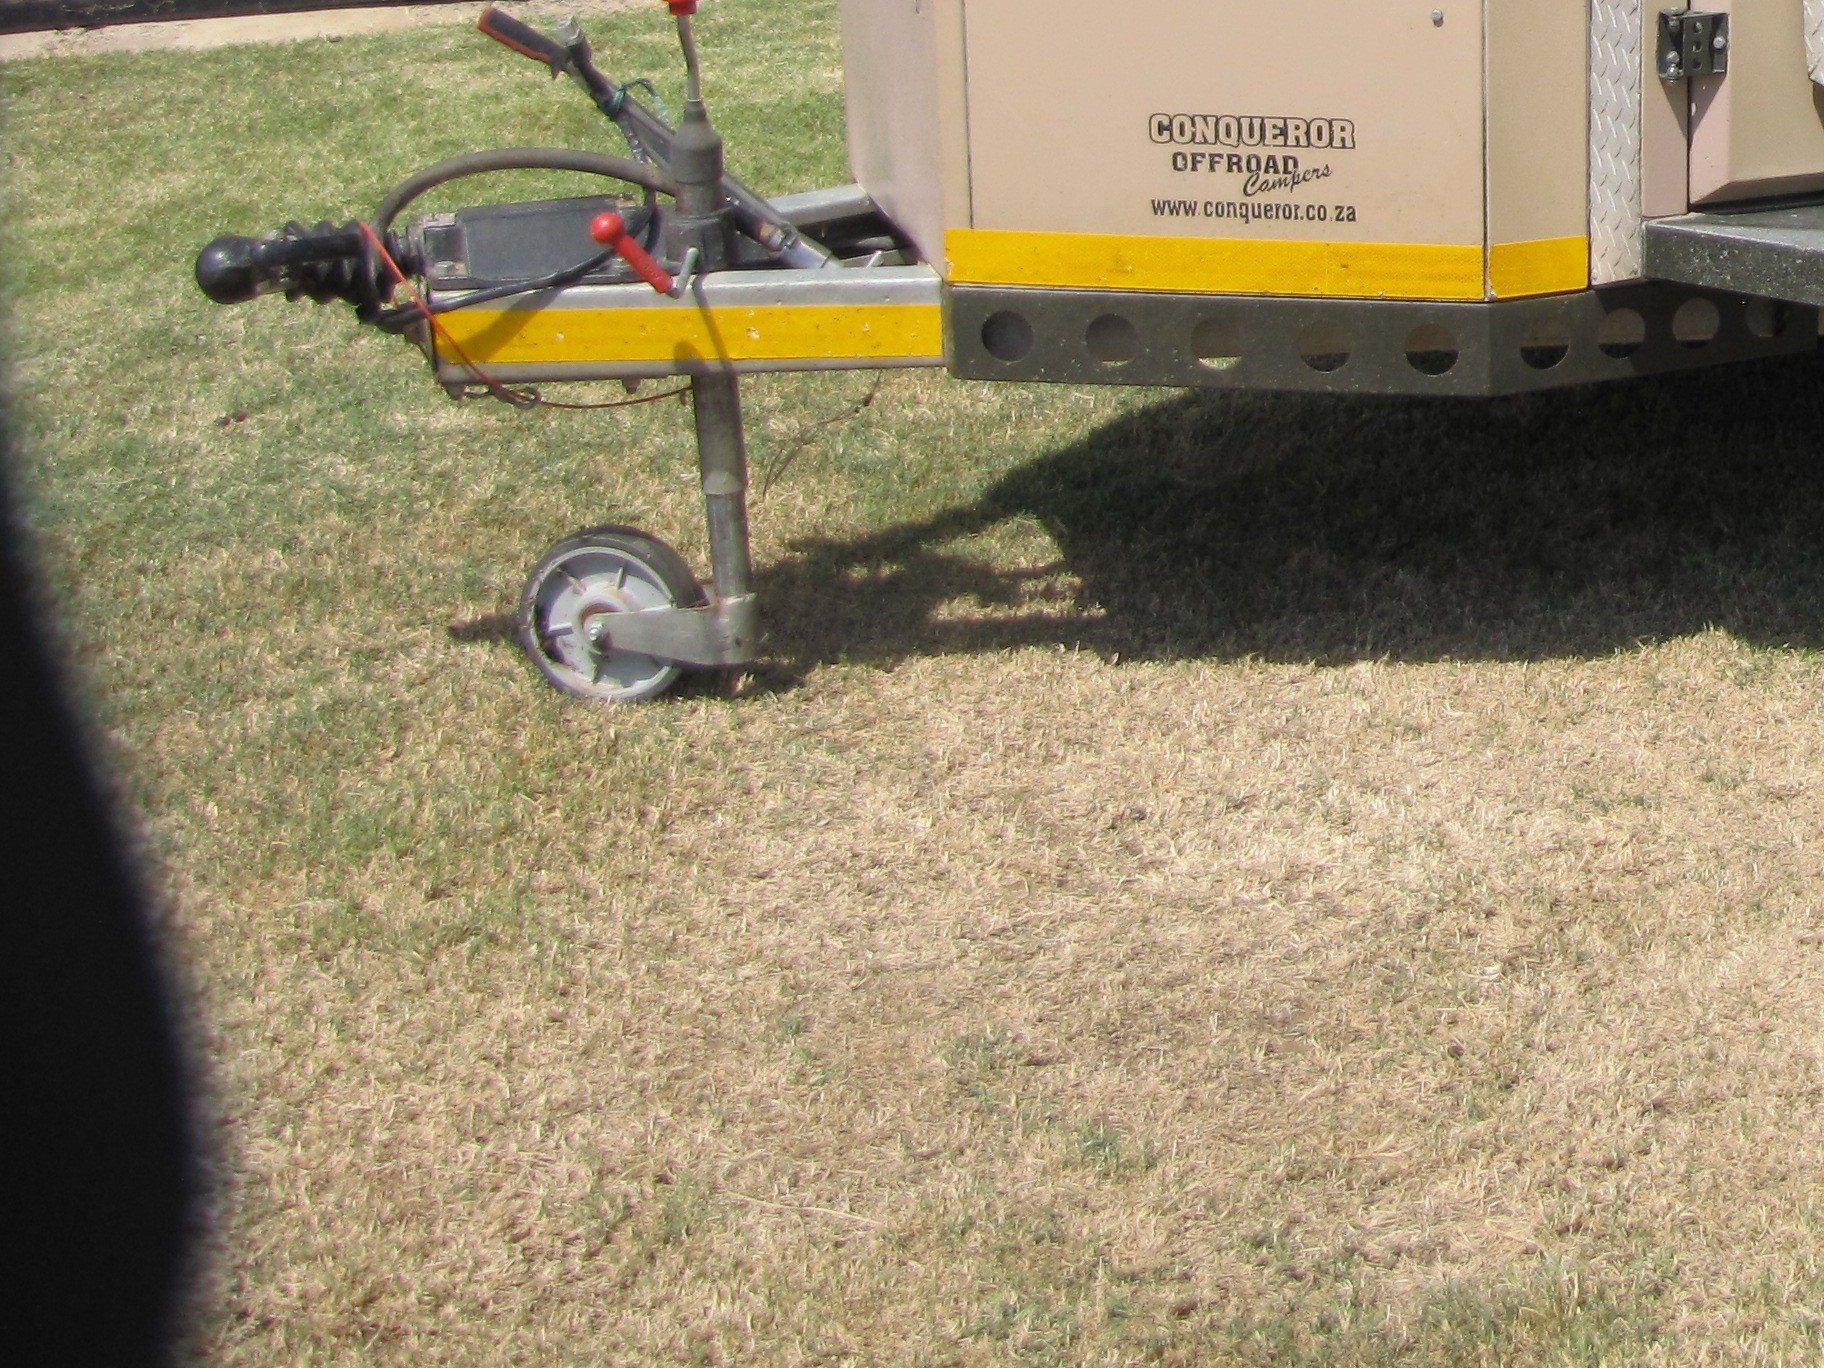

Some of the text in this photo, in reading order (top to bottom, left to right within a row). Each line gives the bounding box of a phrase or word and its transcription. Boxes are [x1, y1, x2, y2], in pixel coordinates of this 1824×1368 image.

[1149, 113, 1356, 150] CONQUEROR
[1171, 151, 1299, 175] OFFROAD
[1242, 163, 1333, 197] Campers
[1151, 198, 1358, 224] www.conqueror.co.za
